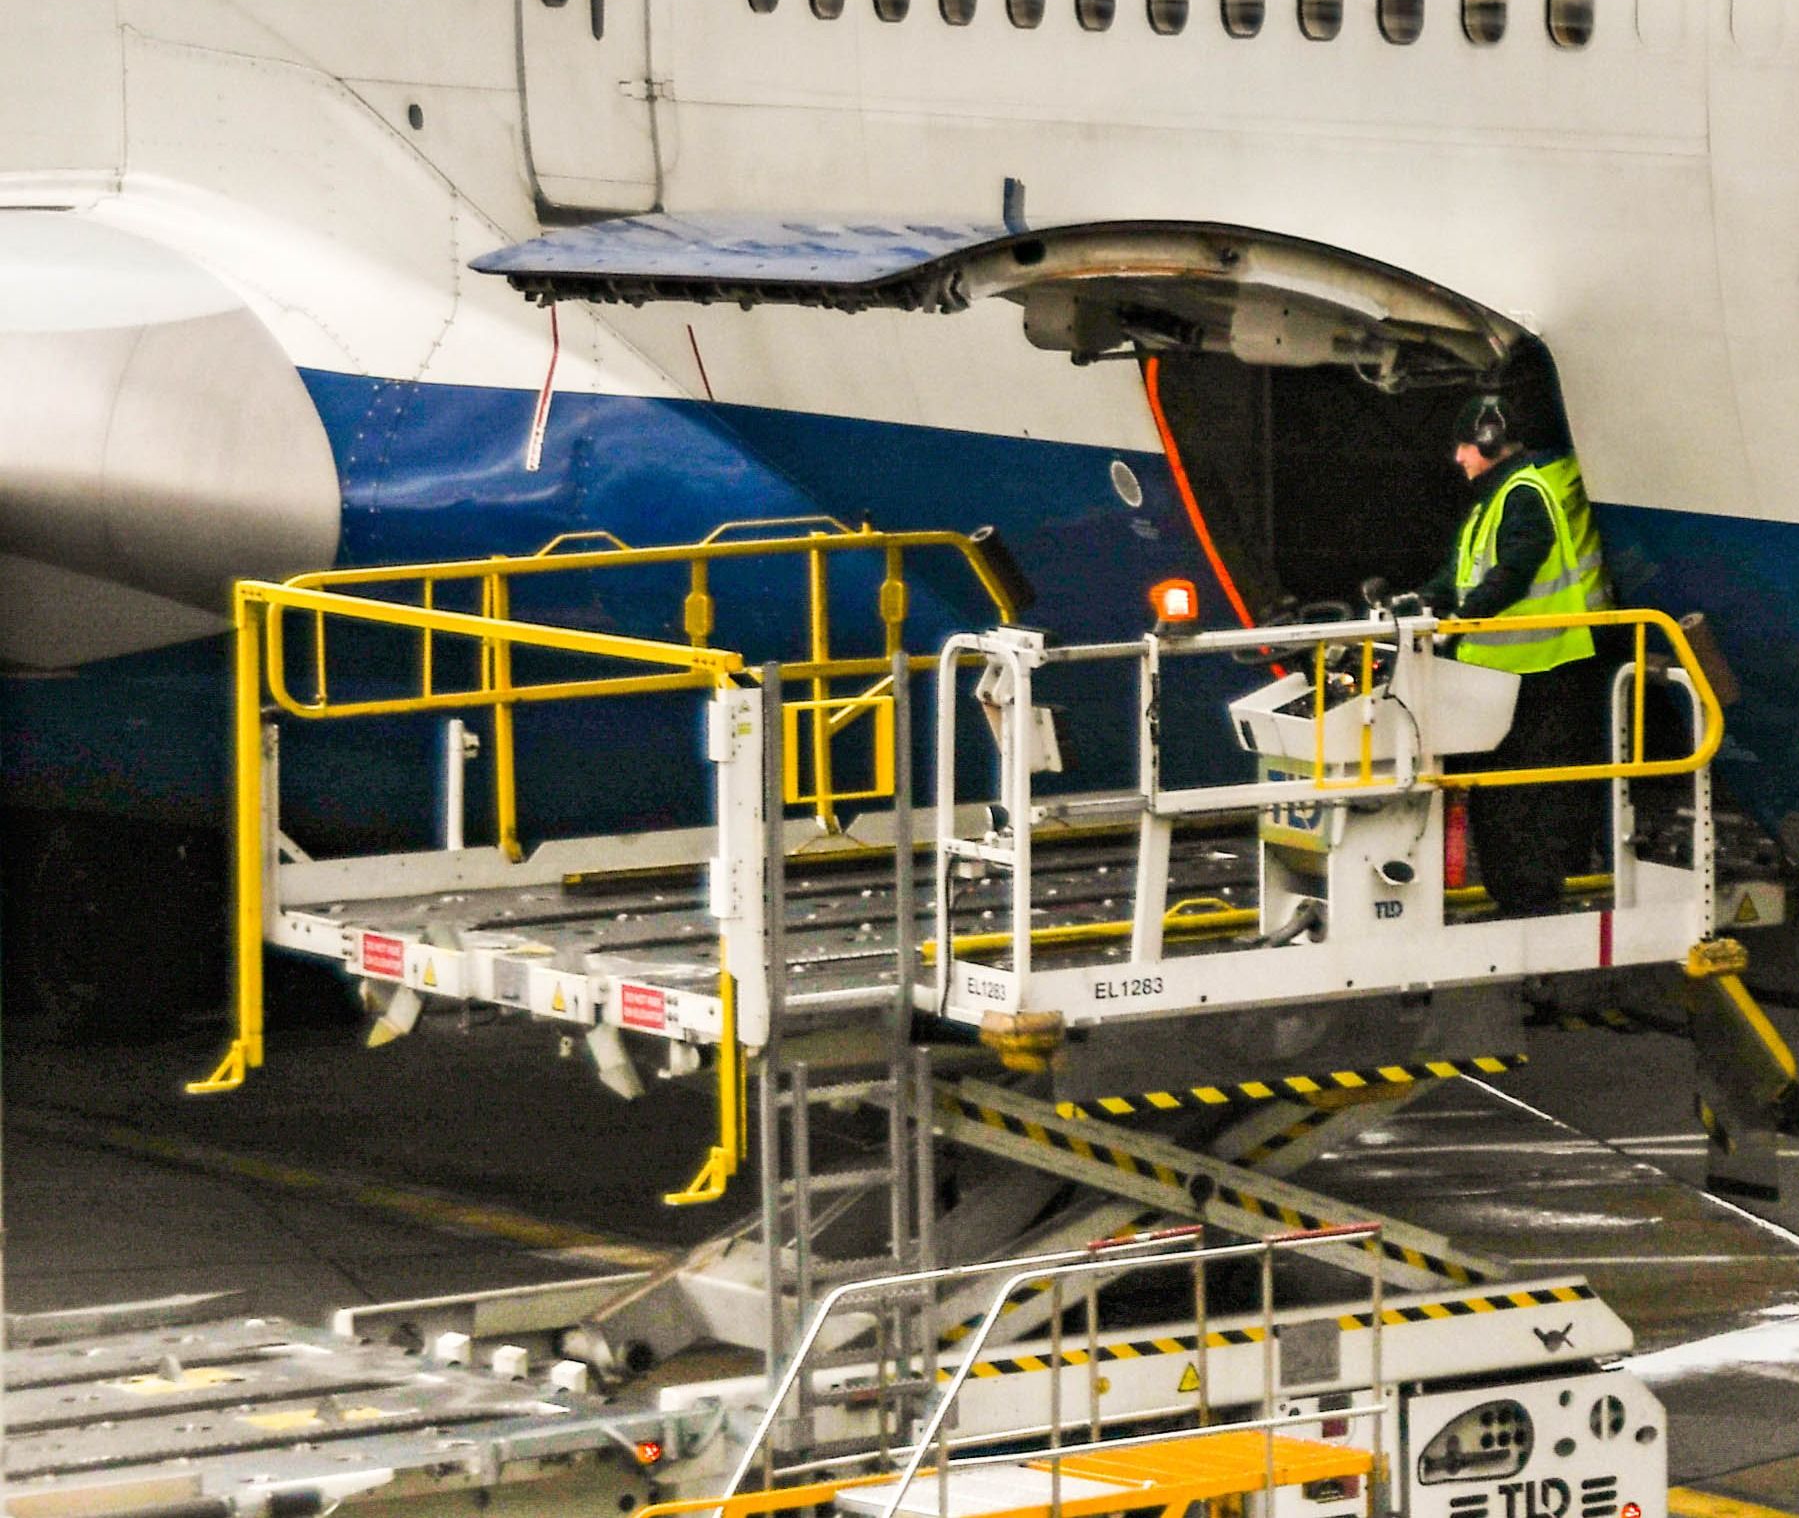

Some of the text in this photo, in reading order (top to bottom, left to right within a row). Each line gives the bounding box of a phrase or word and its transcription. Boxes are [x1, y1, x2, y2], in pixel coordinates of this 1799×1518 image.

[1375, 900, 1404, 920] TLD
[967, 977, 1007, 1001] EL1283
[1095, 977, 1164, 999] EL1283
[1498, 1477, 1572, 1518] TLD
